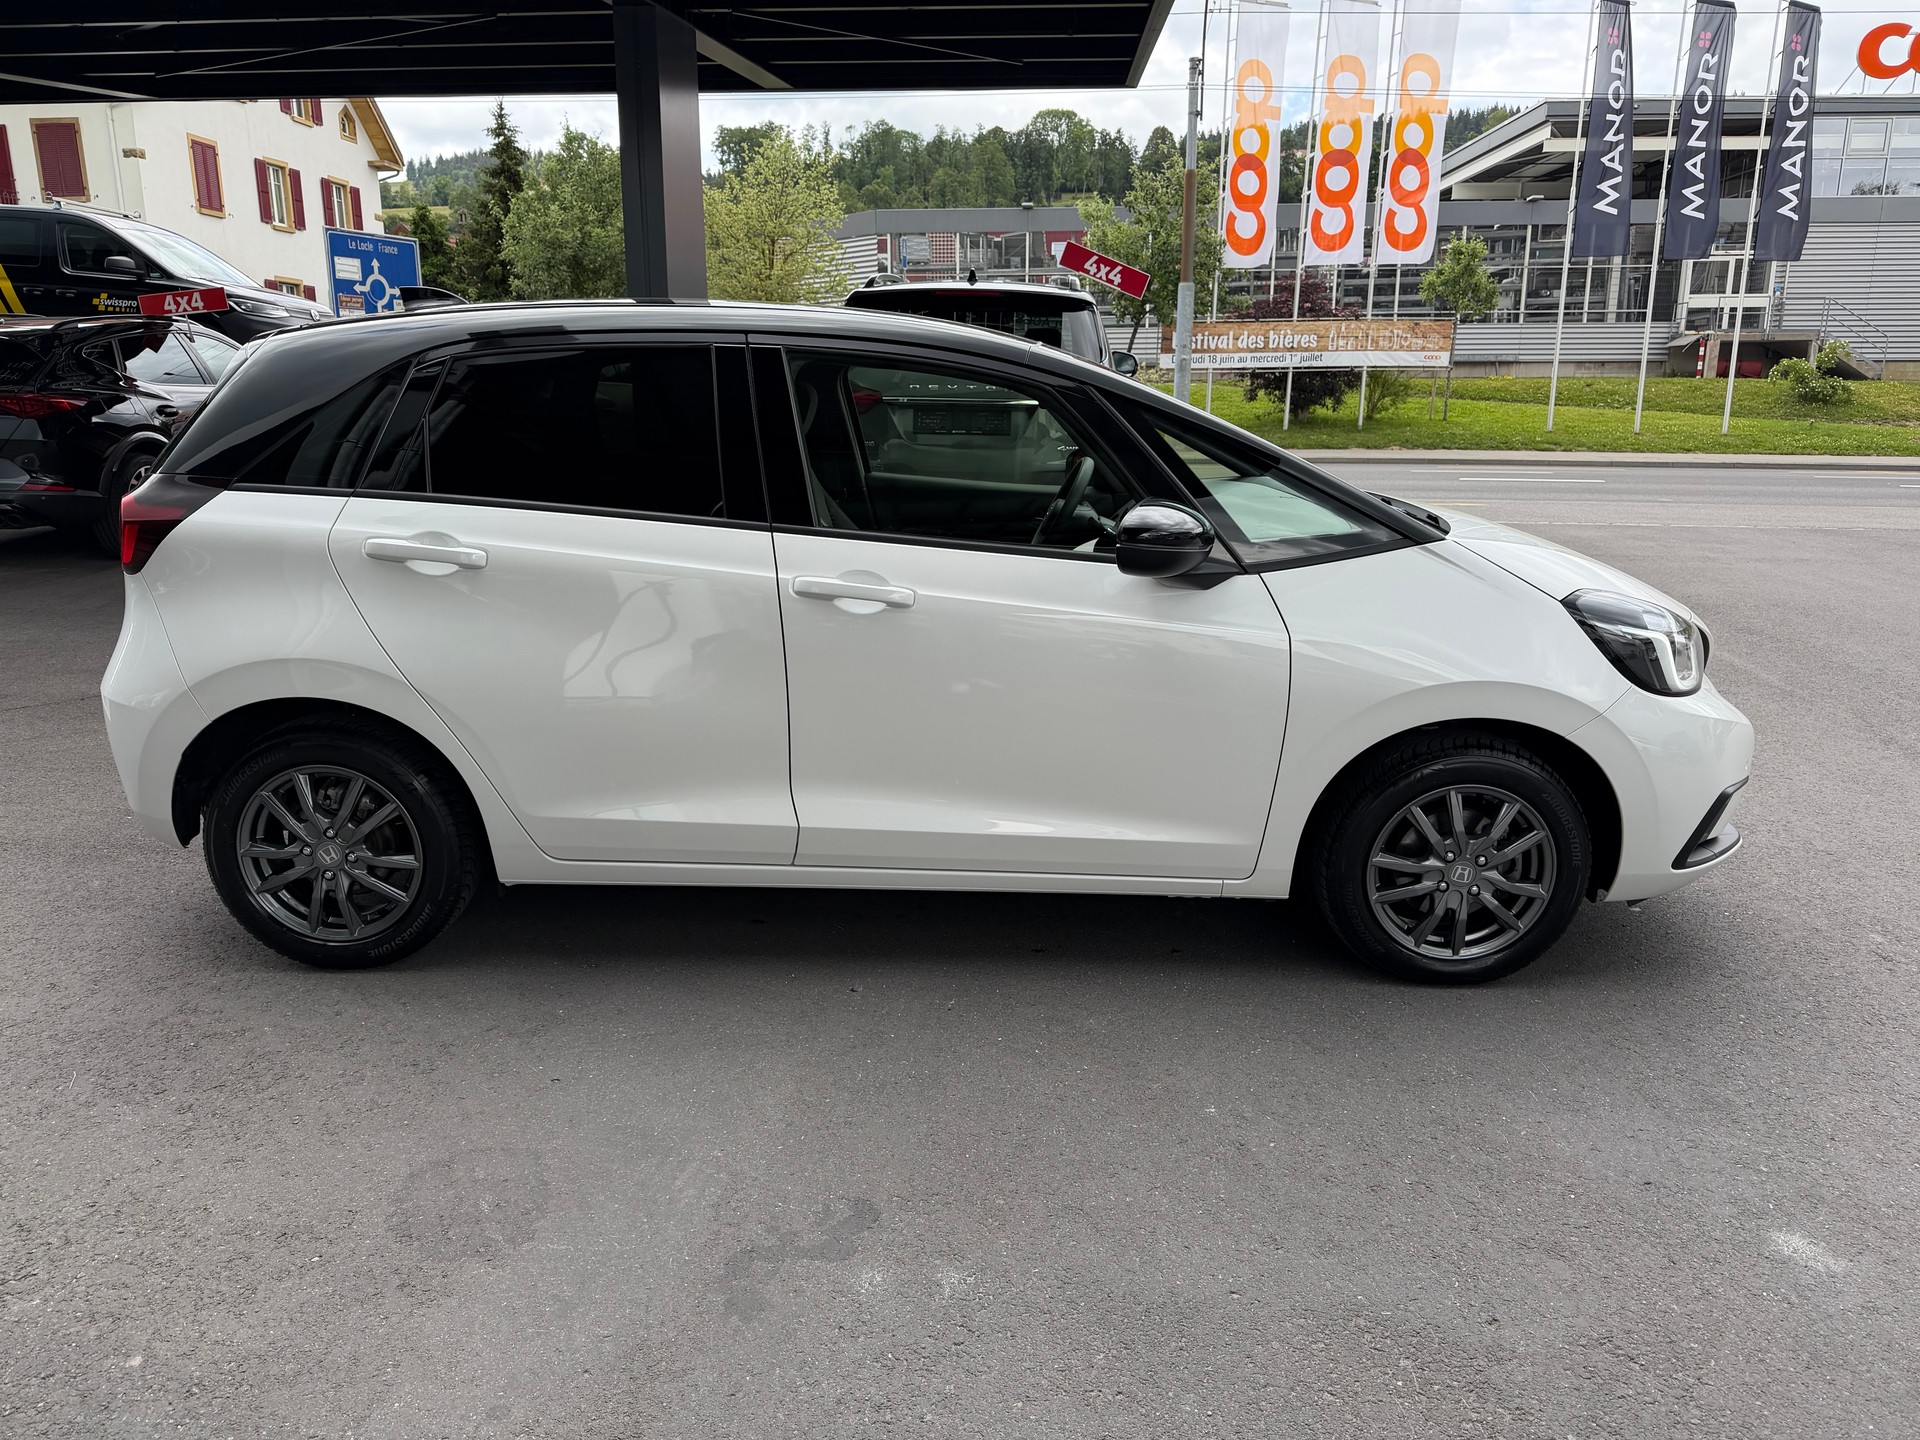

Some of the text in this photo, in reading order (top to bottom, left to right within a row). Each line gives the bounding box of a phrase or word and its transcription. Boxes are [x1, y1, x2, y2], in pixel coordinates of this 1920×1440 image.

[1225, 58, 1281, 256] coop
[1310, 54, 1375, 252] coop
[1384, 52, 1449, 252] coop
[1592, 49, 1626, 215] MANOR
[1680, 52, 1719, 220] MANOR
[1776, 55, 1810, 221] MANOR
[348, 239, 398, 255] Le Locle France
[1083, 255, 1124, 286] 4x4
[100, 296, 137, 308] swisspro
[163, 291, 205, 313] 4x4
[1237, 331, 1265, 350] des
[1268, 329, 1318, 350] bières
[1208, 355, 1217, 364] 18
[1218, 355, 1235, 366] juin
[1237, 356, 1248, 364] au
[1250, 353, 1287, 364] mercredi
[1299, 353, 1323, 364] juillet
